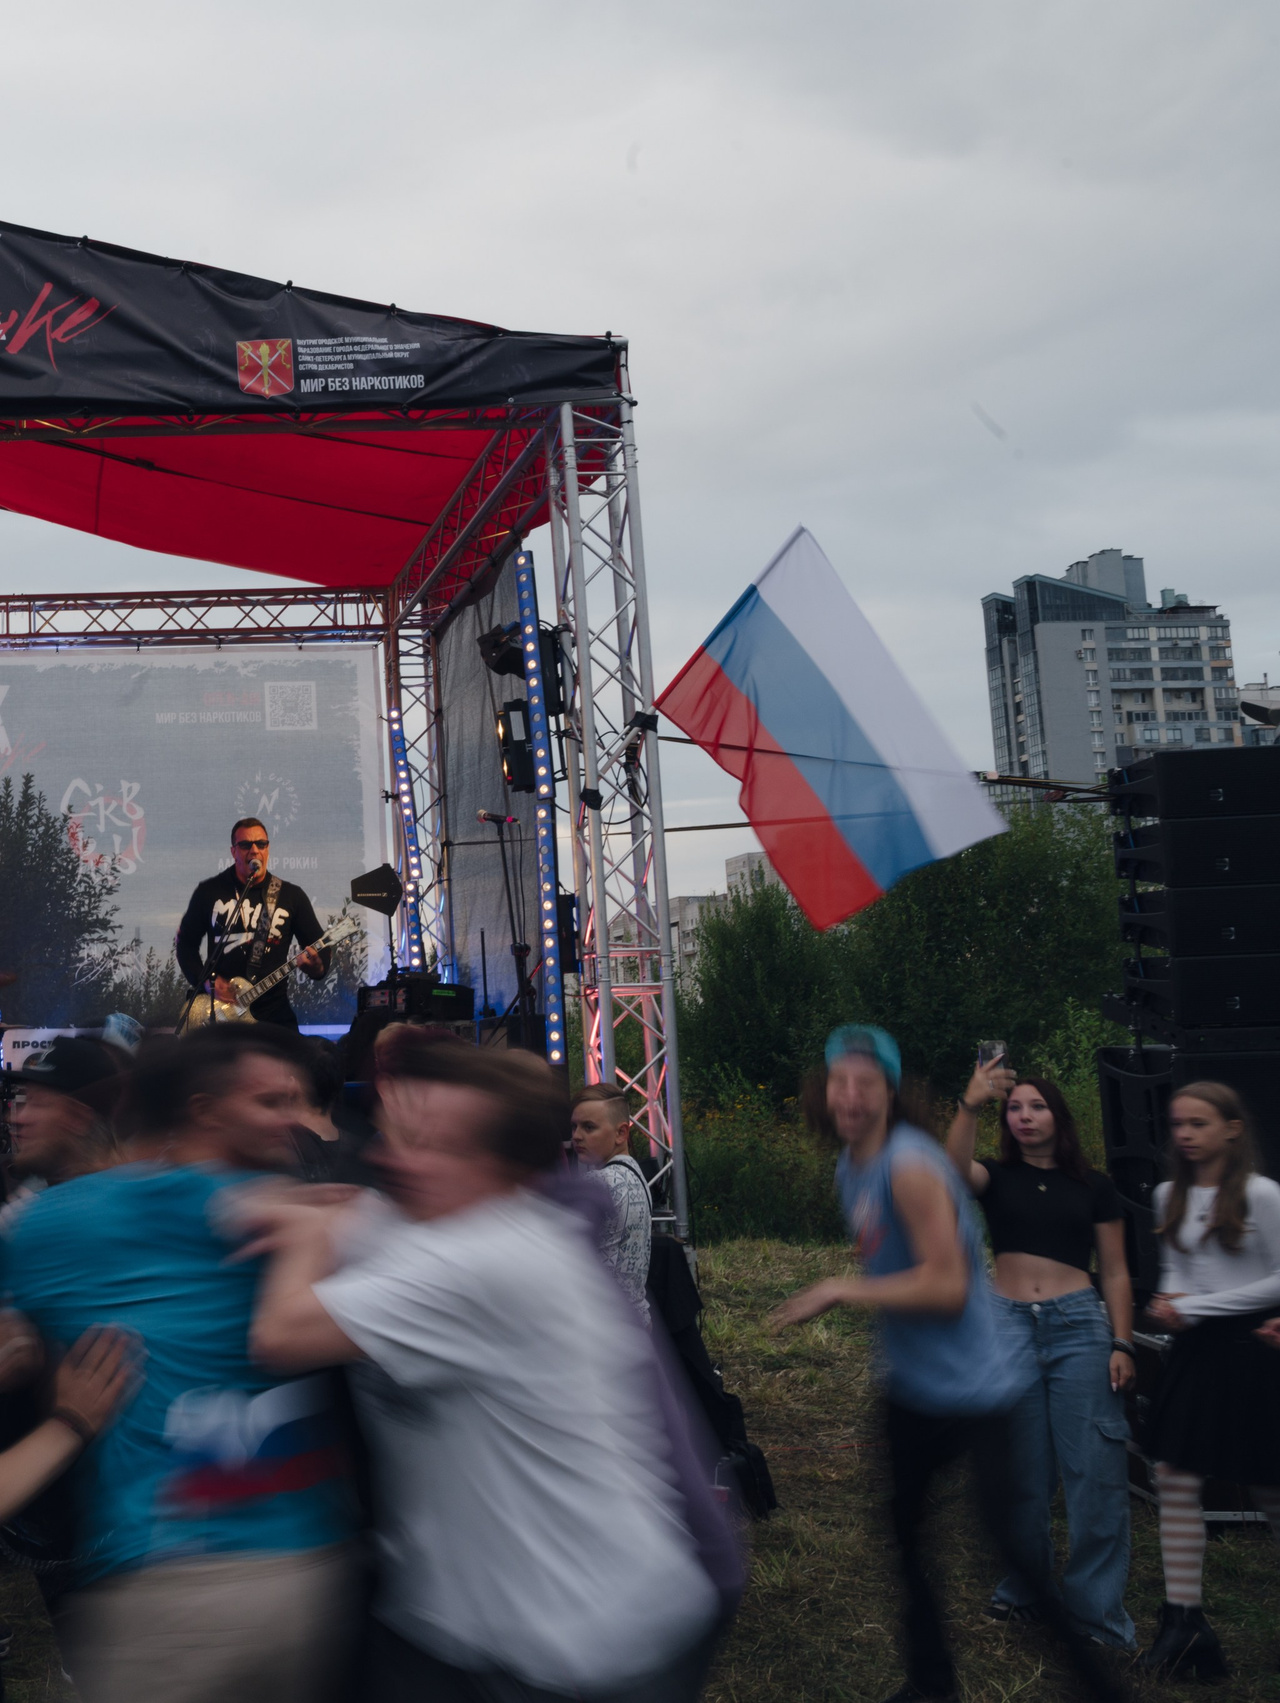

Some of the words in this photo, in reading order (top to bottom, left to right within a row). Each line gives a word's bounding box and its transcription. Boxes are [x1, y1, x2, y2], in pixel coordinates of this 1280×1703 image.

[300, 378, 325, 393] МИР
[328, 377, 350, 391] БЕЗ
[352, 374, 425, 390] НАРКОТИКОВ
[155, 712, 177, 724] МИР
[178, 711, 197, 723] БЕЗ
[199, 711, 262, 724] НАРКОТИКОВ
